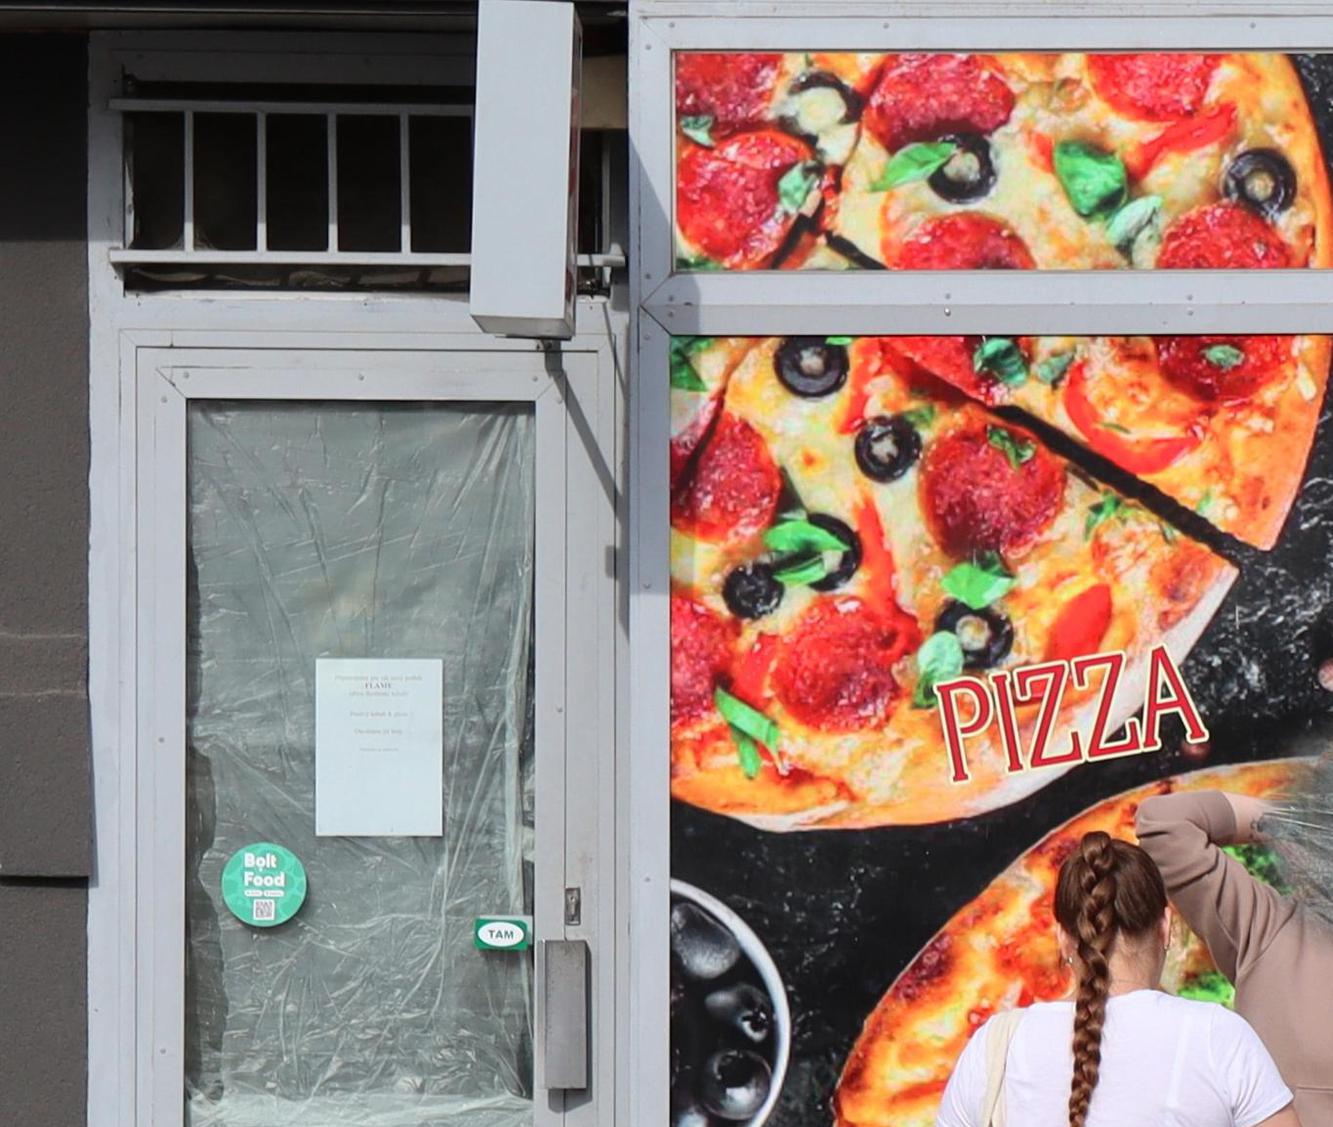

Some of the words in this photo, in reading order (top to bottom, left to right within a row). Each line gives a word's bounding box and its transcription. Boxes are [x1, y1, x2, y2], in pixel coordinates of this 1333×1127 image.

[932, 643, 1211, 784] PIZZA
[244, 853, 277, 872] Bolt
[244, 871, 285, 887] Food
[488, 929, 514, 939] TAM
